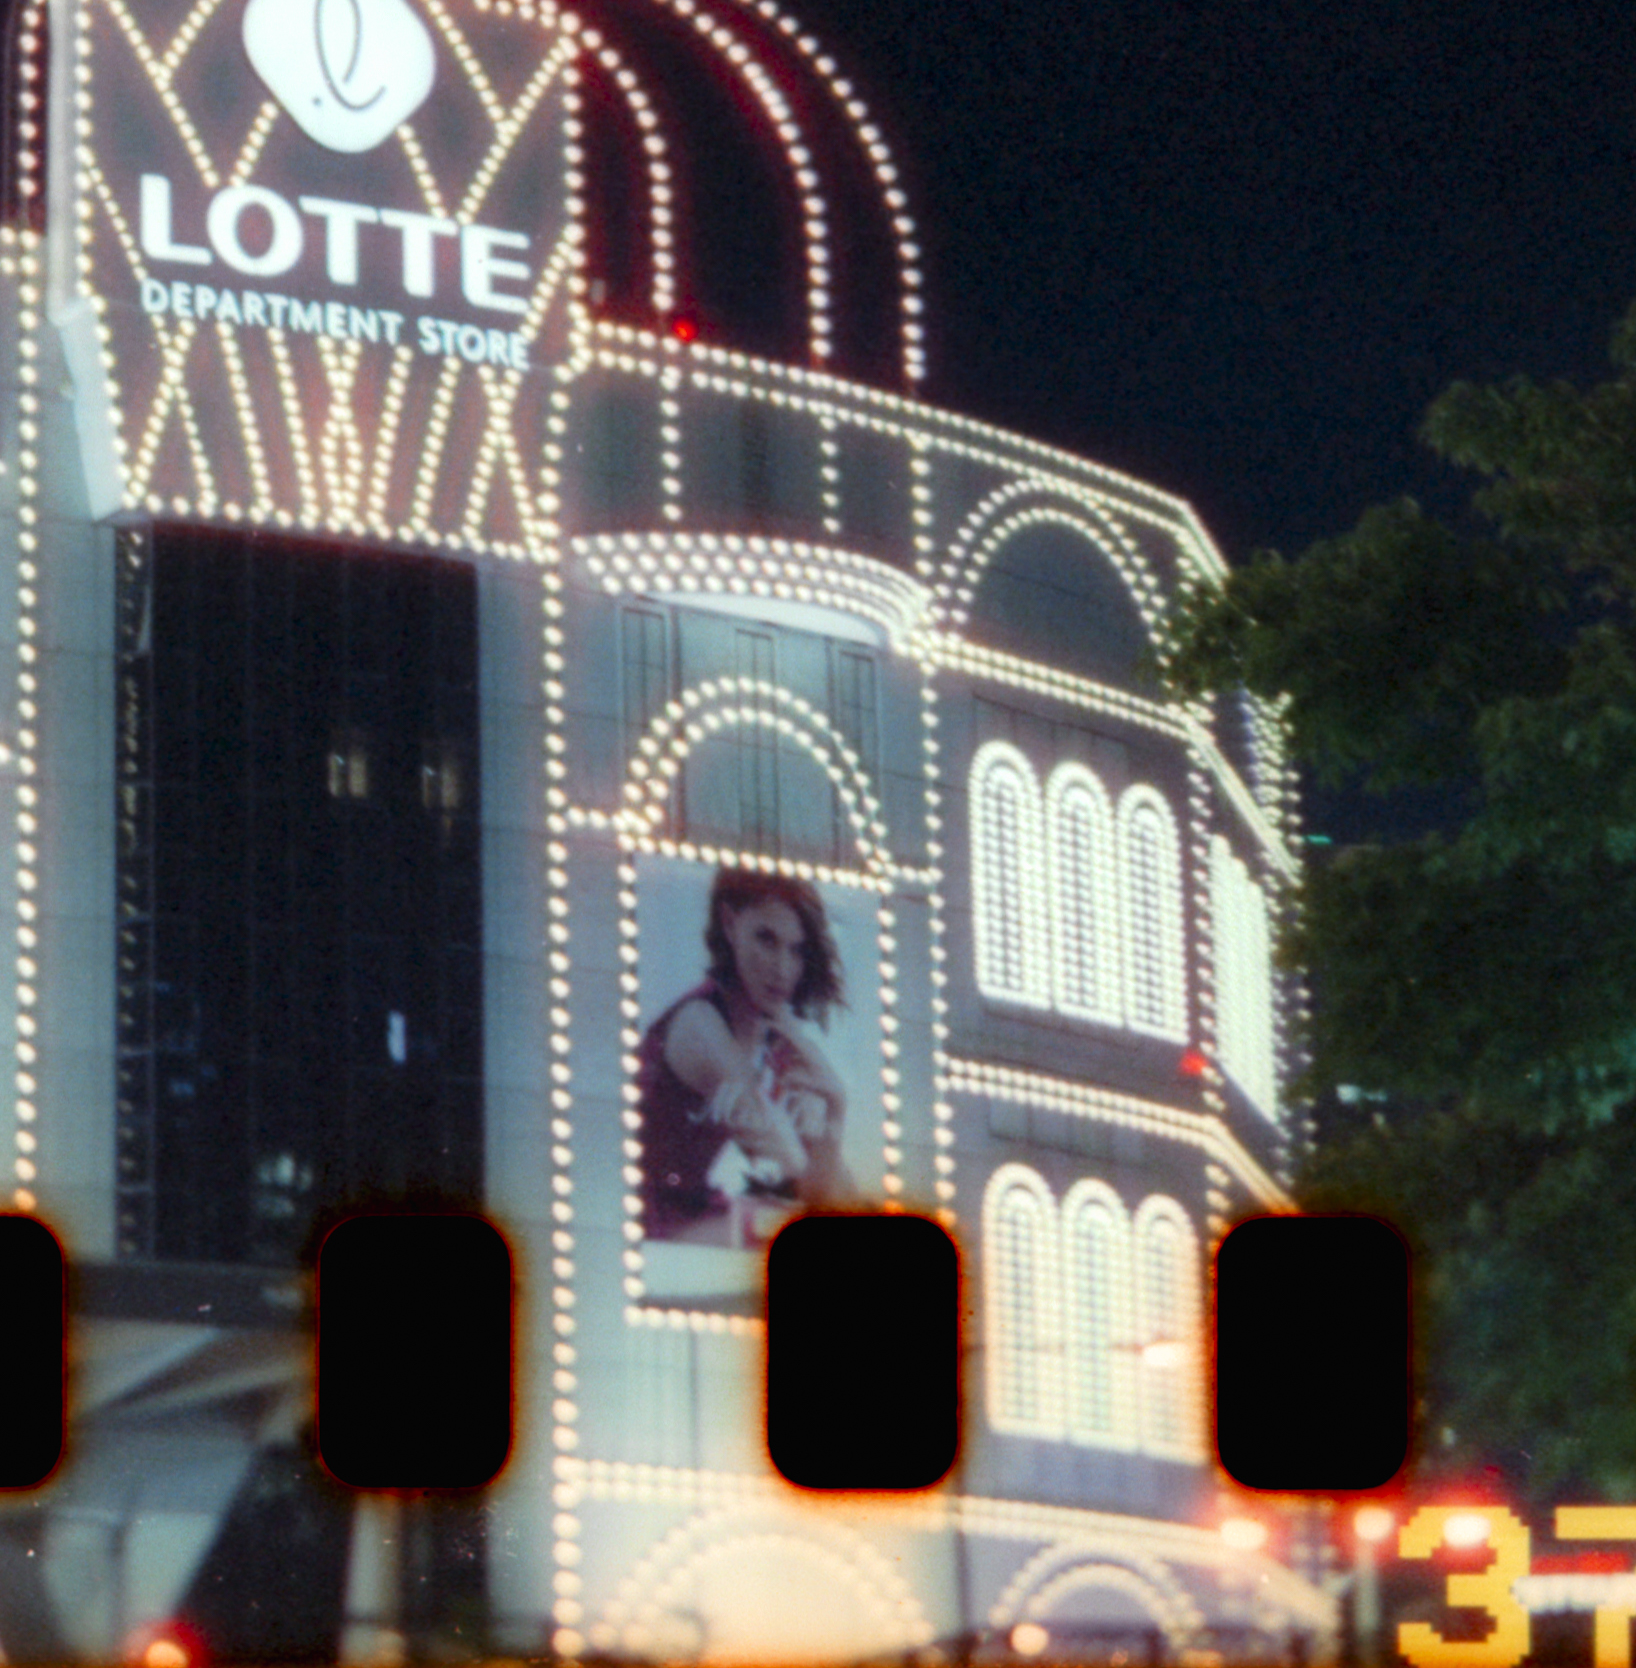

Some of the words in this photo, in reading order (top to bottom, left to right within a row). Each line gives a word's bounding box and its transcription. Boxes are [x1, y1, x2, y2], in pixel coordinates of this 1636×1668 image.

[140, 173, 530, 314] LOTTE
[142, 277, 404, 346] DEPARTMENT
[418, 315, 531, 371] STORE
